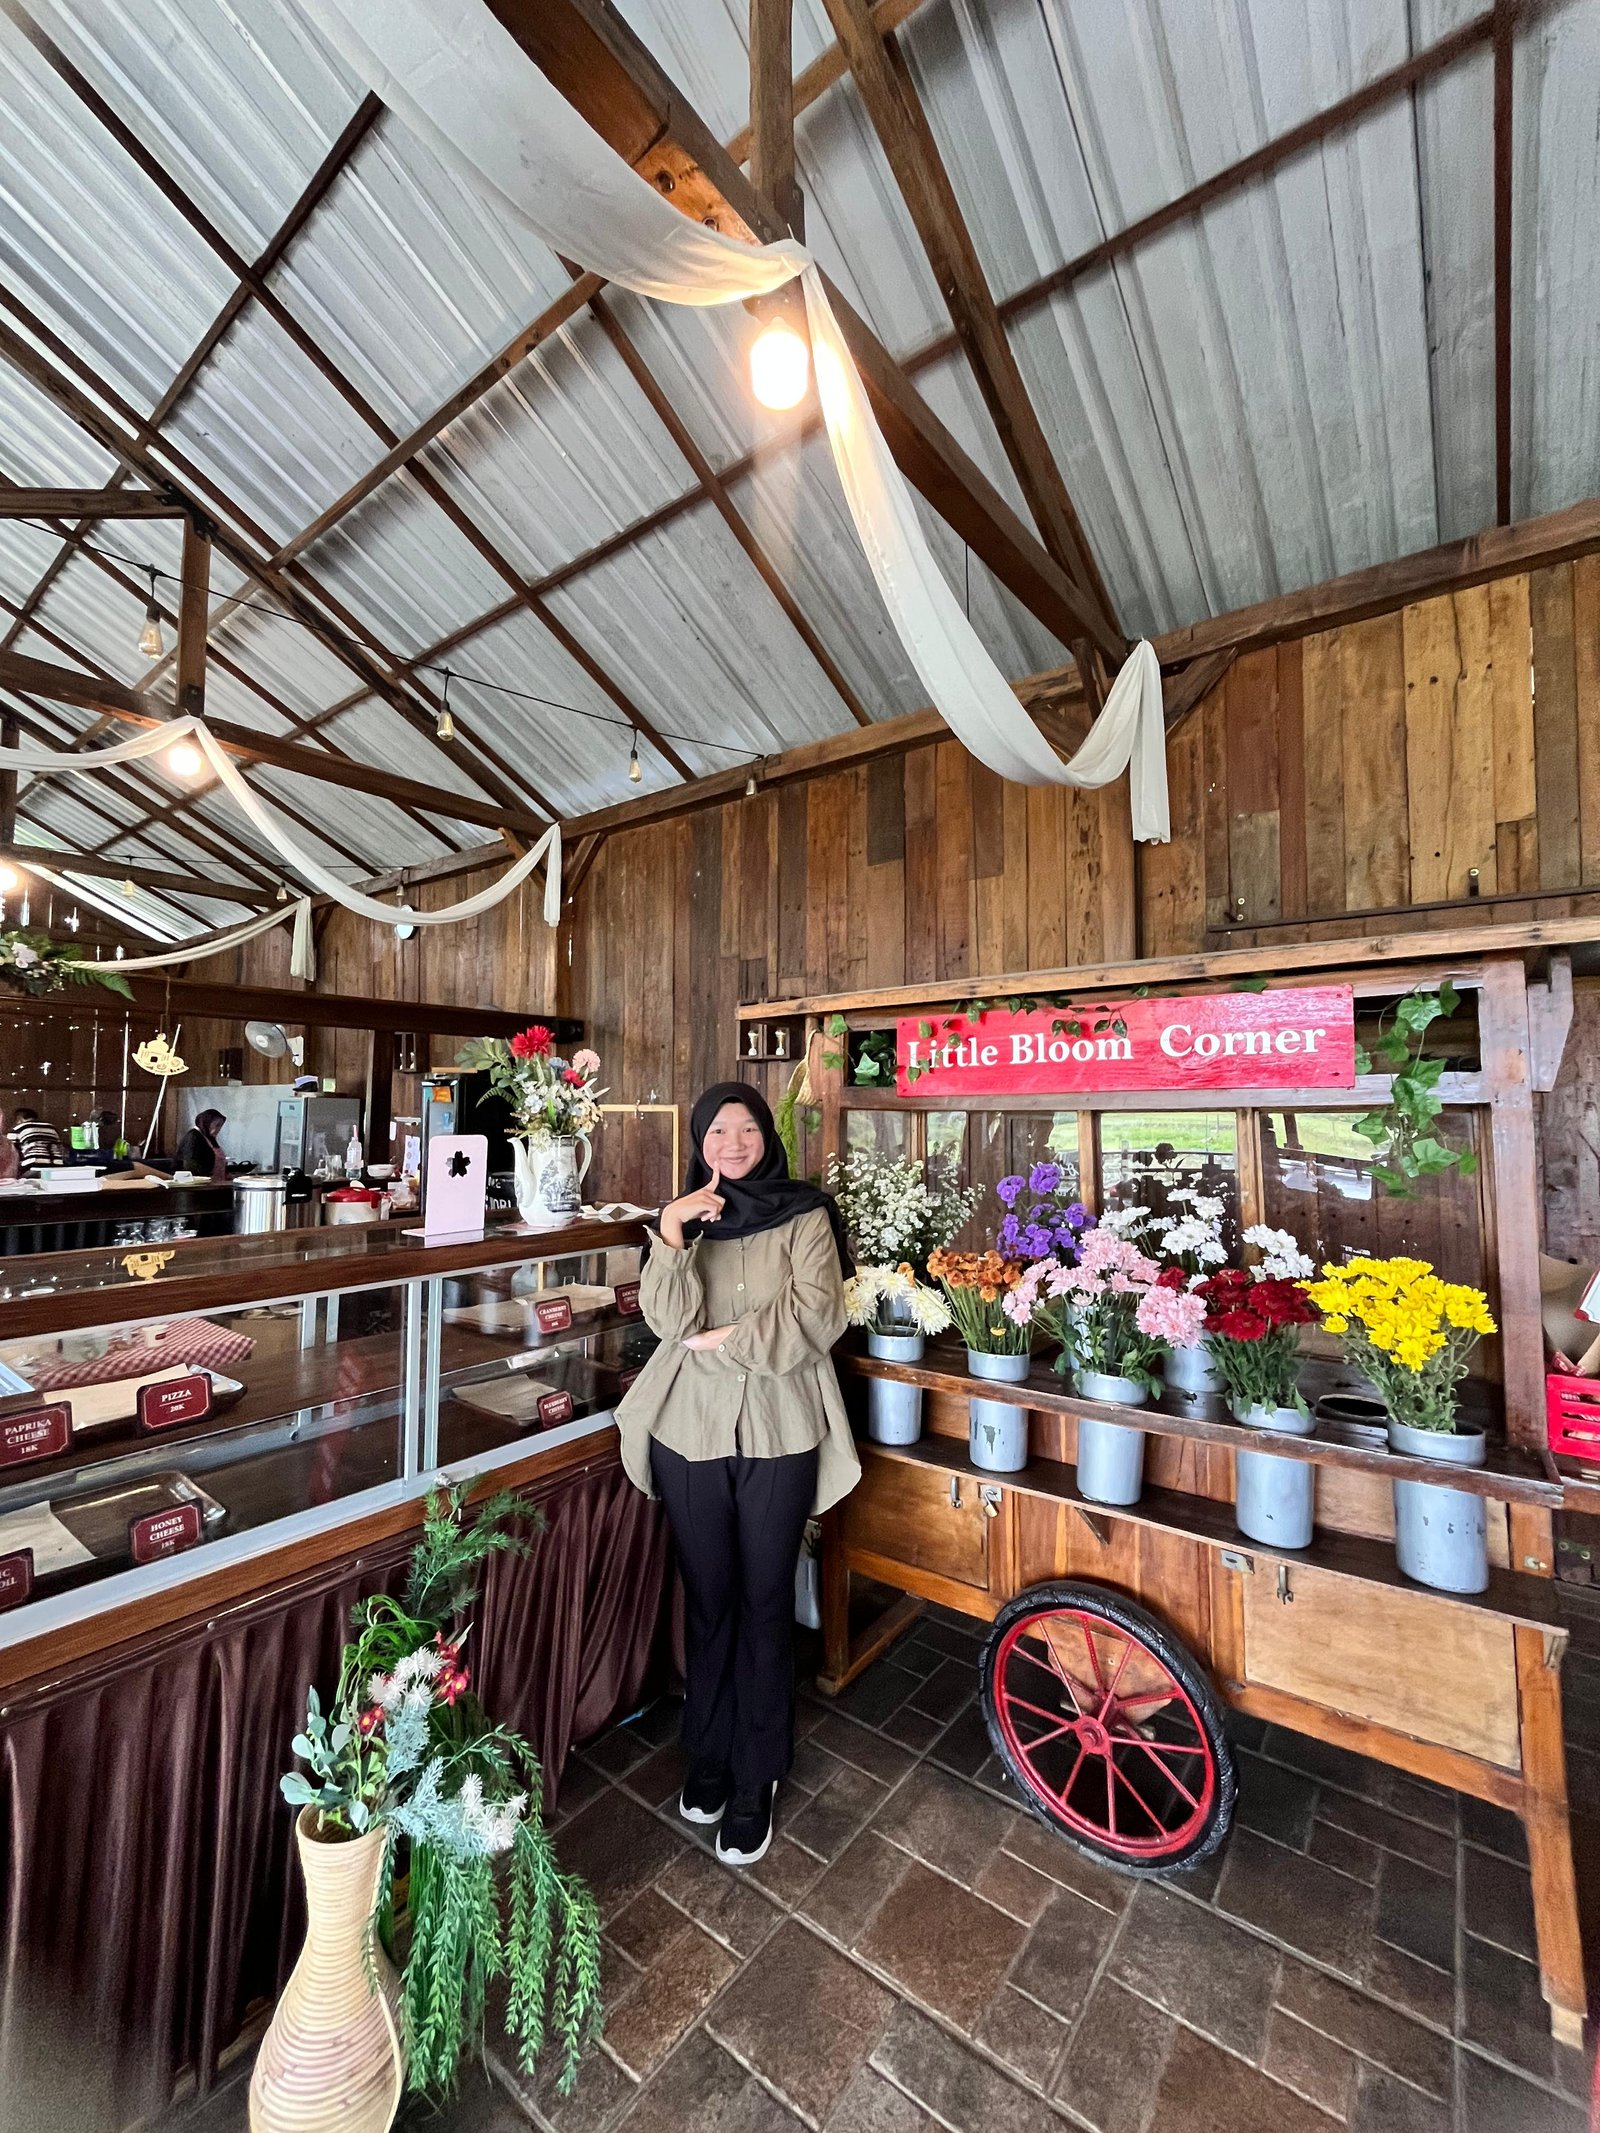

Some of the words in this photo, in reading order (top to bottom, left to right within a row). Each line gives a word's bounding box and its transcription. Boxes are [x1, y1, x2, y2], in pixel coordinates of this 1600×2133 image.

[907, 1036, 998, 1068] Little
[1008, 1033, 1134, 1065] Bloom
[1159, 1023, 1326, 1057] Corner
[161, 1388, 192, 1403] PIZZA
[170, 1402, 185, 1413] 20K
[5, 1418, 52, 1436] PAPRIKA
[6, 1428, 50, 1445] CHEESE
[21, 1444, 38, 1454] 18K
[151, 1515, 183, 1532] HONEY
[149, 1523, 185, 1542] CHEESE
